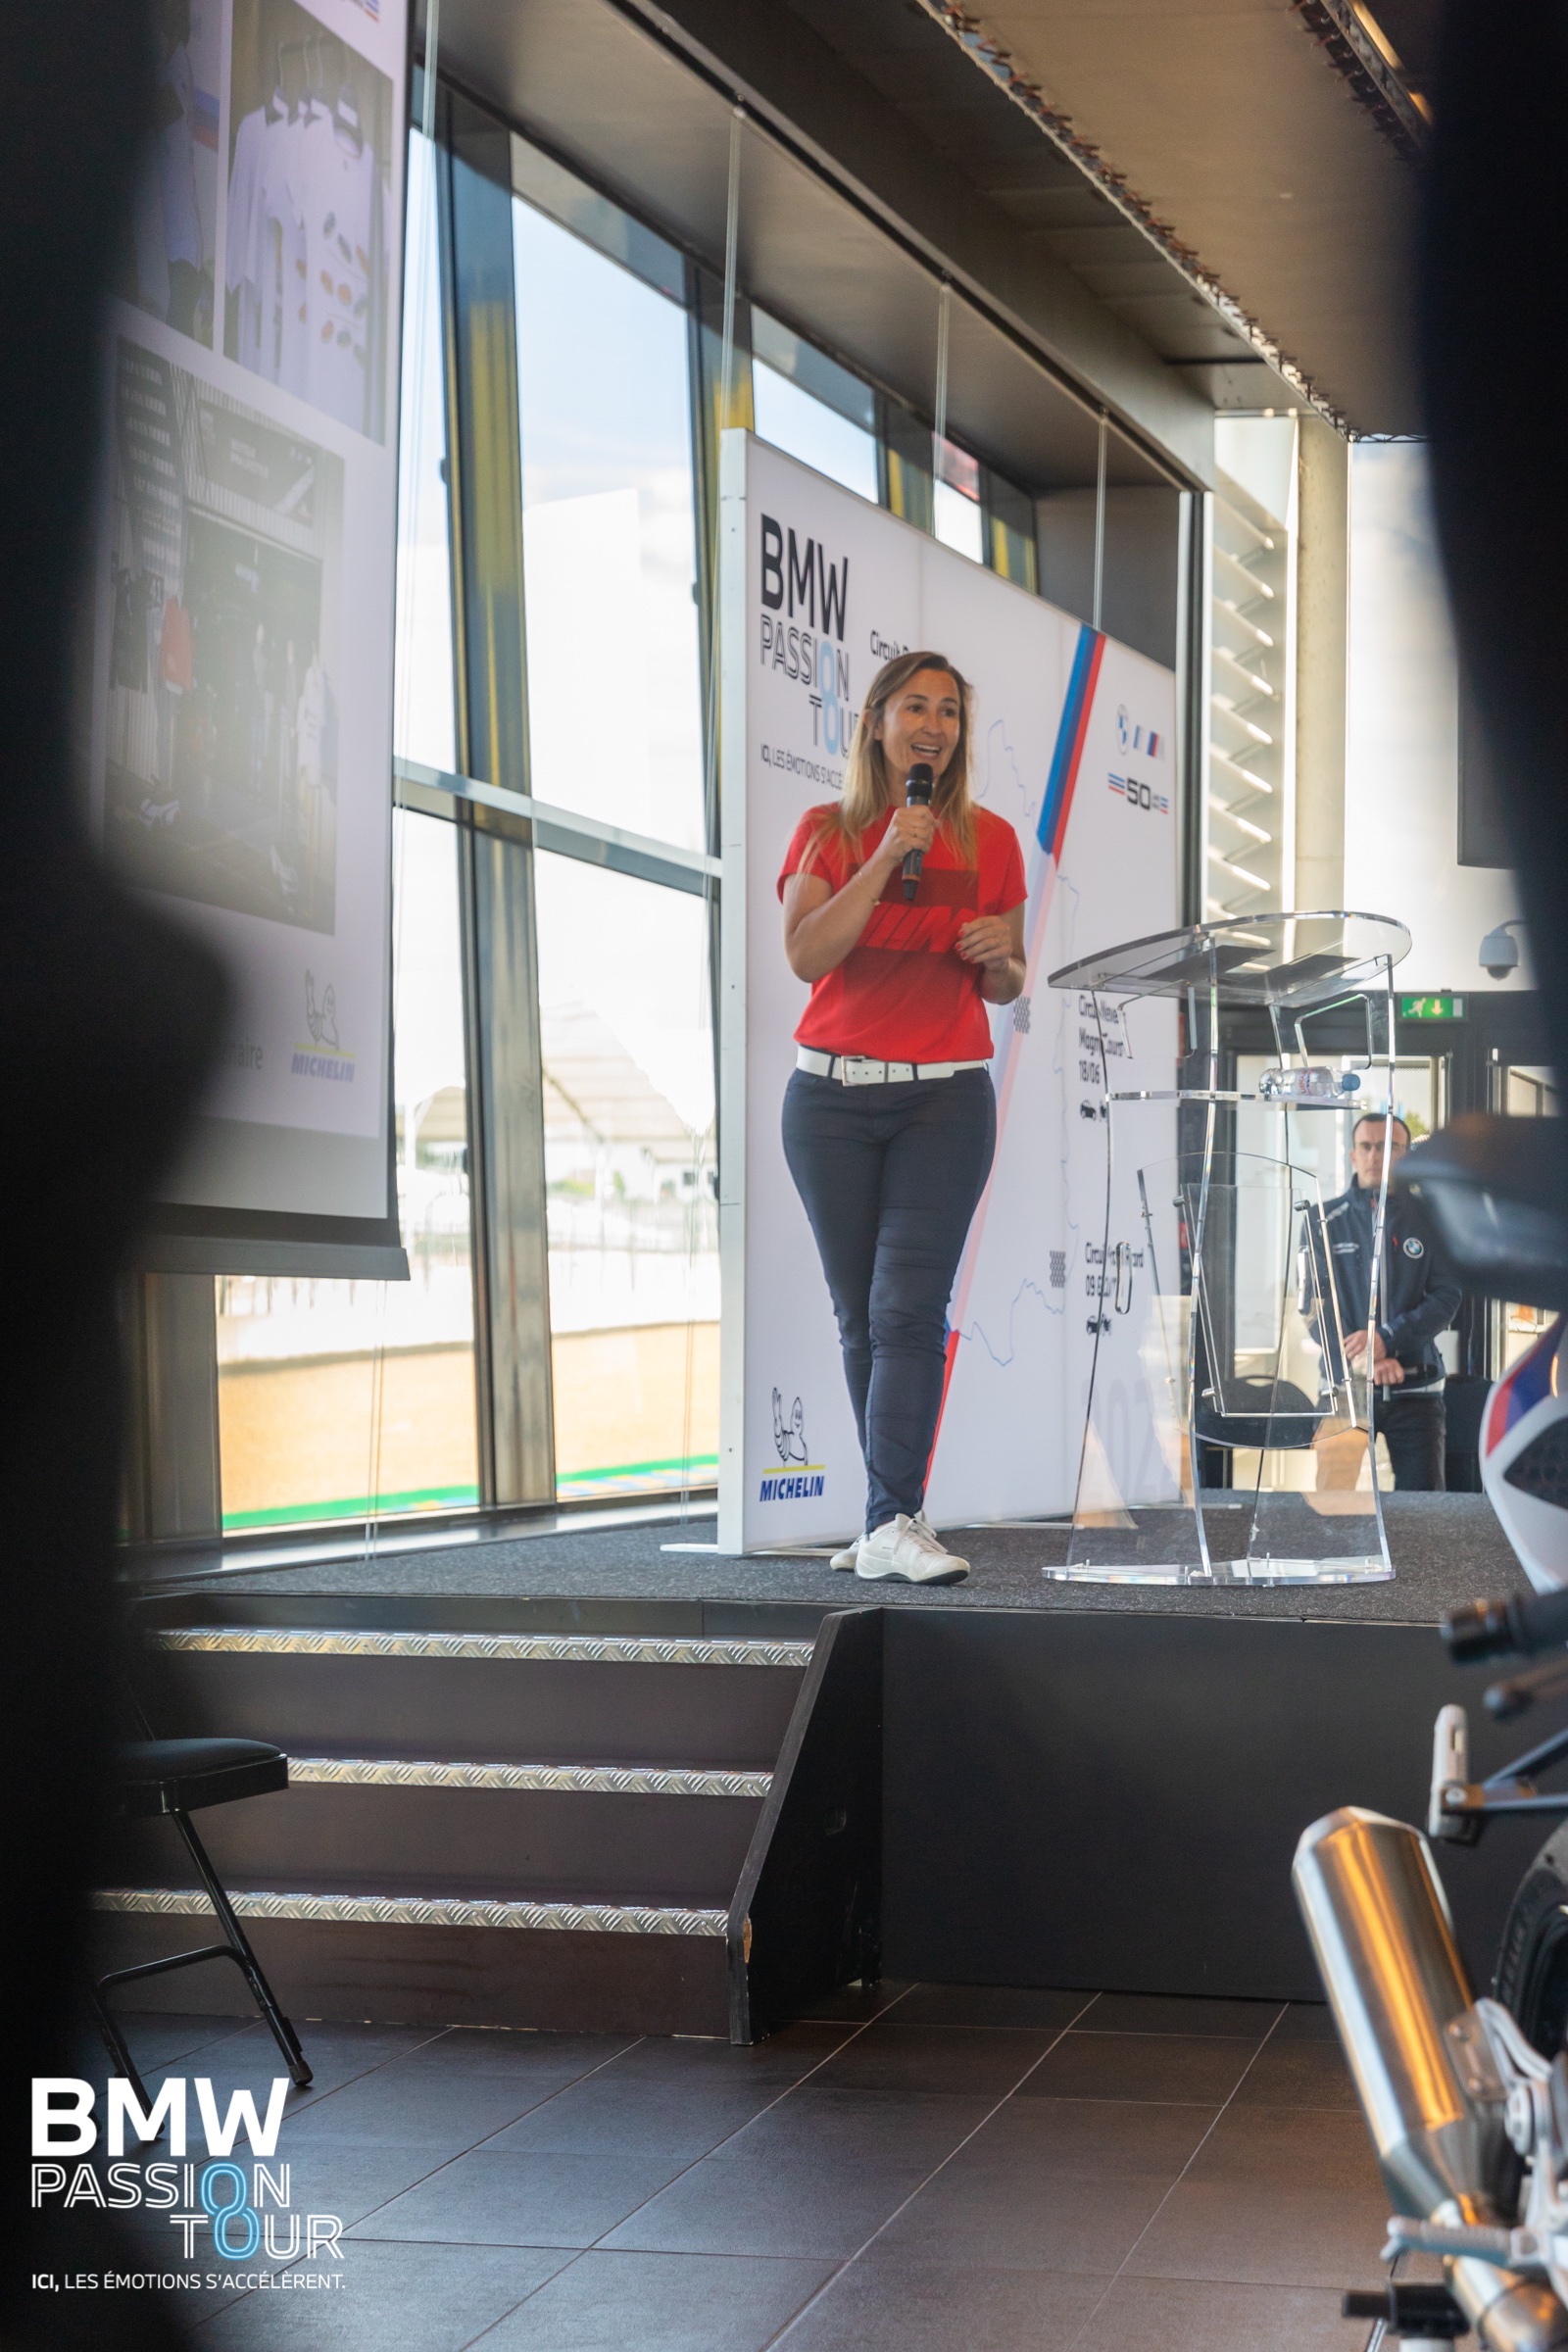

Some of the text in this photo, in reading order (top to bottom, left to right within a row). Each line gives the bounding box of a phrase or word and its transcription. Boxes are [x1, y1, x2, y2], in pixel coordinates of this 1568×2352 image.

[760, 513, 849, 642] BMW
[760, 613, 850, 702] PASSION
[772, 748, 785, 768] LES
[1127, 776, 1152, 811] 50
[291, 1053, 356, 1083] MICHELIN
[759, 1475, 825, 1502] MICHELIN
